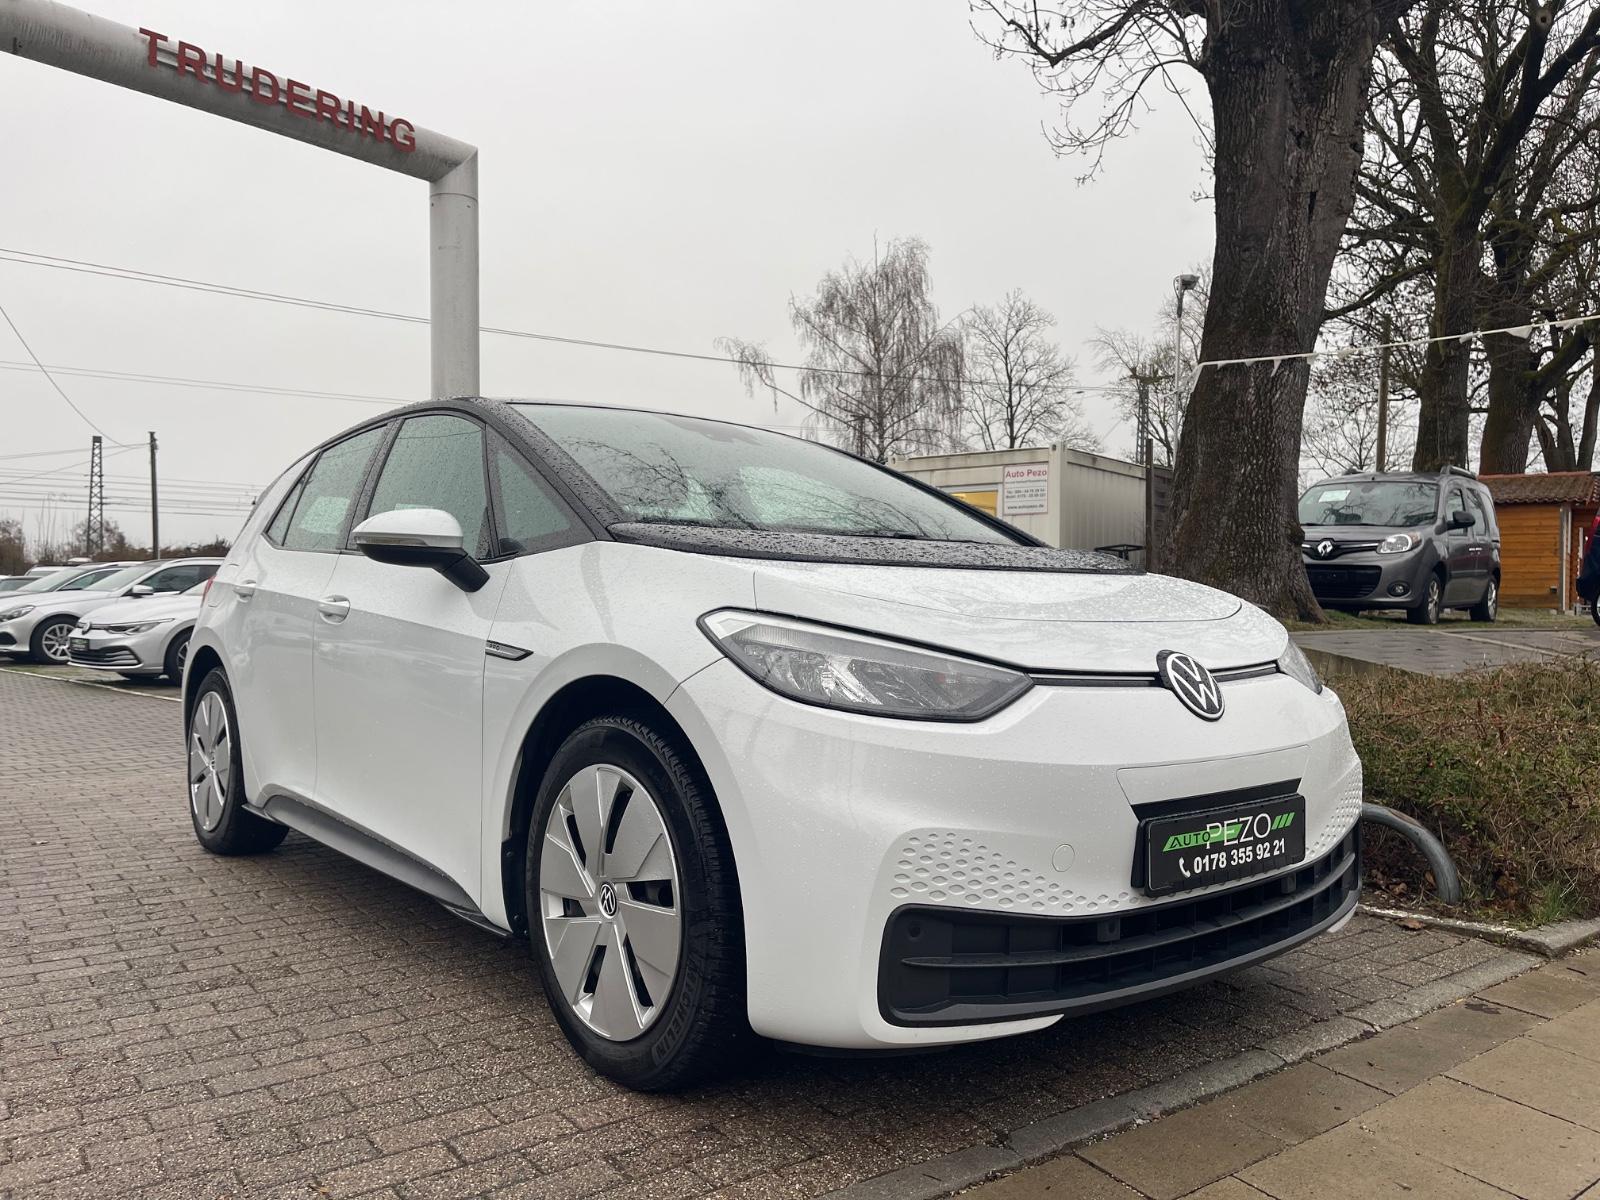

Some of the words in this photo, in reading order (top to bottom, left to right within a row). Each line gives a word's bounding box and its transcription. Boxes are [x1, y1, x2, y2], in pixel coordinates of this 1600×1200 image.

[139, 27, 416, 152] TRUDERING
[1027, 469, 1047, 477] Pezo
[1169, 831, 1211, 849] AUTO
[1206, 813, 1272, 850] PEZO
[1193, 852, 1227, 874] 0178
[1230, 846, 1253, 866] 355
[1256, 842, 1270, 860] 92
[1273, 838, 1286, 855] 21
